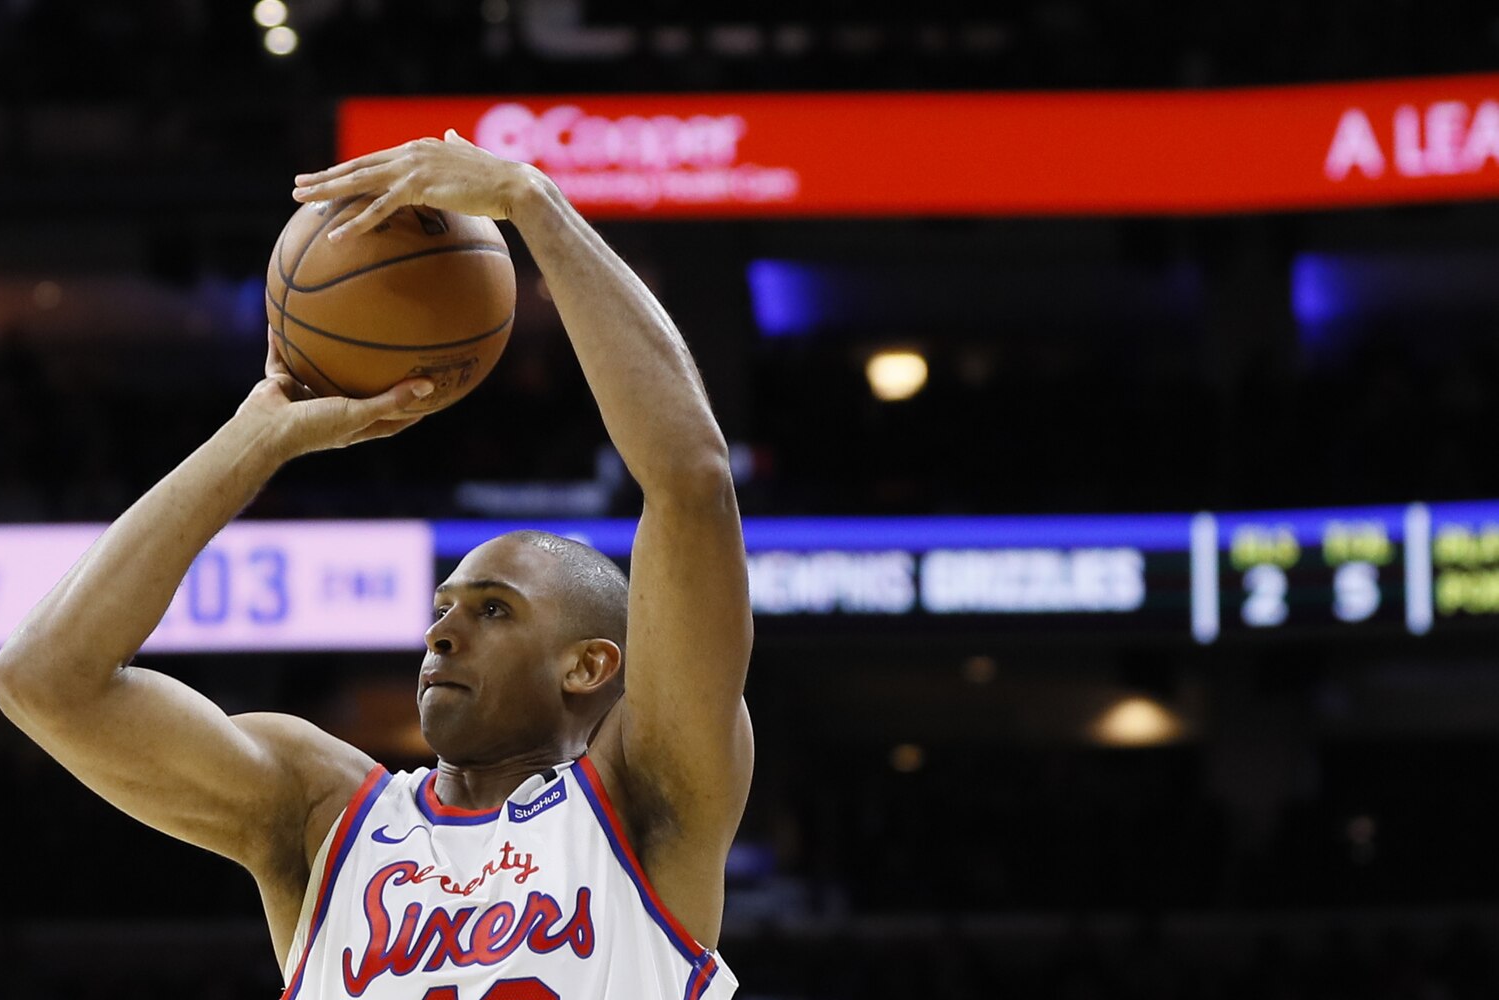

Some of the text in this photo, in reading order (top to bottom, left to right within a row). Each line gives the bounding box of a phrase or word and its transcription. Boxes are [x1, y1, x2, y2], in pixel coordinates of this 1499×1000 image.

[536, 104, 746, 172] Cooper
[1323, 106, 1387, 182] A
[920, 546, 1146, 613] GRIZZLIES
[1242, 560, 1381, 627] 2 5
[514, 790, 561, 819] StubHub
[342, 861, 595, 998] Sixers
